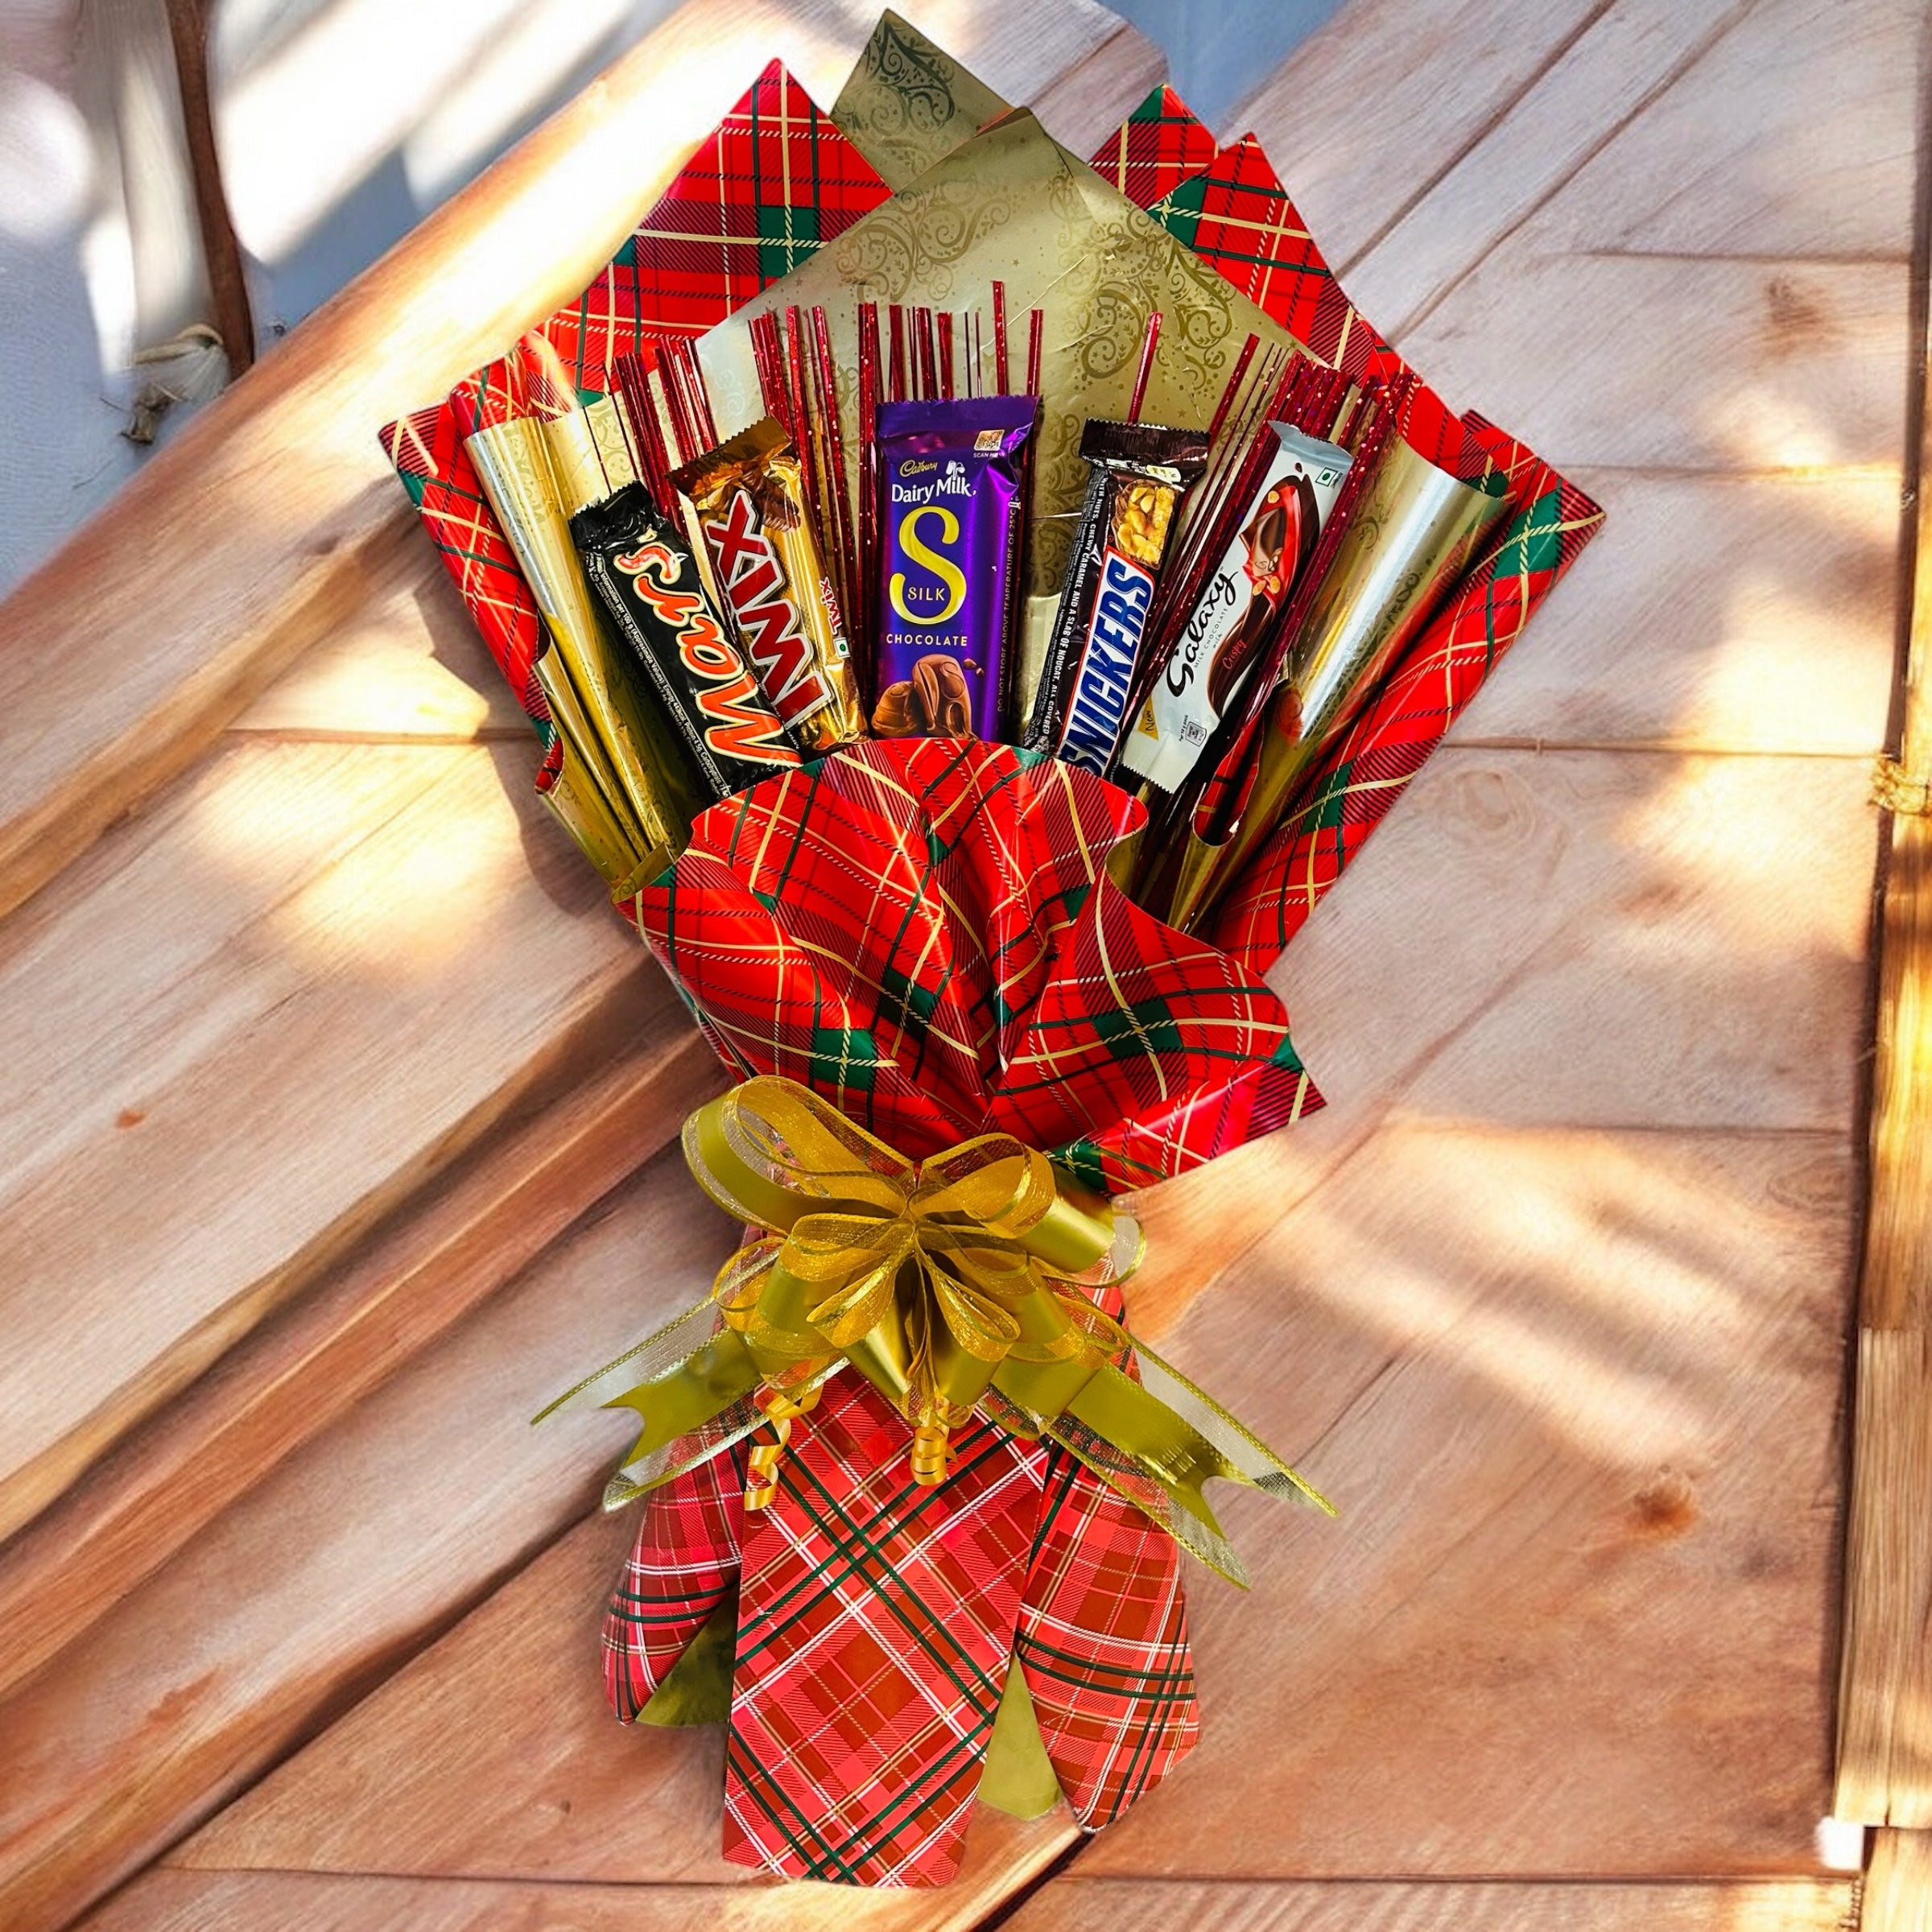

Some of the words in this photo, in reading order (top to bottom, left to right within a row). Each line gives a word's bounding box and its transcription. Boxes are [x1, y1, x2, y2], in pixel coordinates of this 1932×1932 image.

[899, 460, 938, 477] Cadbury
[892, 484, 935, 504] Dairy
[1097, 477, 1108, 497] WITH
[1084, 523, 1096, 551] CHEWY
[1074, 551, 1089, 588] CARAMEL
[819, 576, 842, 635] TWIX
[907, 587, 945, 601] SILK
[1070, 590, 1080, 607] AND
[706, 489, 833, 729] TWIX
[997, 698, 1003, 712] DO
[1003, 547, 1013, 610] TEMPERATURE
[1008, 531, 1014, 544] OF
[886, 634, 968, 646] CHOCOLATE
[1062, 616, 1074, 636] SLAB
[1166, 571, 1238, 697] Galaxy
[1194, 653, 1204, 668] MILK
[1204, 608, 1228, 650] CHOCOLATE
[614, 541, 803, 767] Mars
[1059, 637, 1069, 648] OF
[1222, 638, 1247, 670] Crispy
[1059, 557, 1154, 776] SNICKERS
[663, 683, 675, 703] Energy
[1042, 700, 1055, 734] COVERED
[1146, 710, 1154, 732] New
